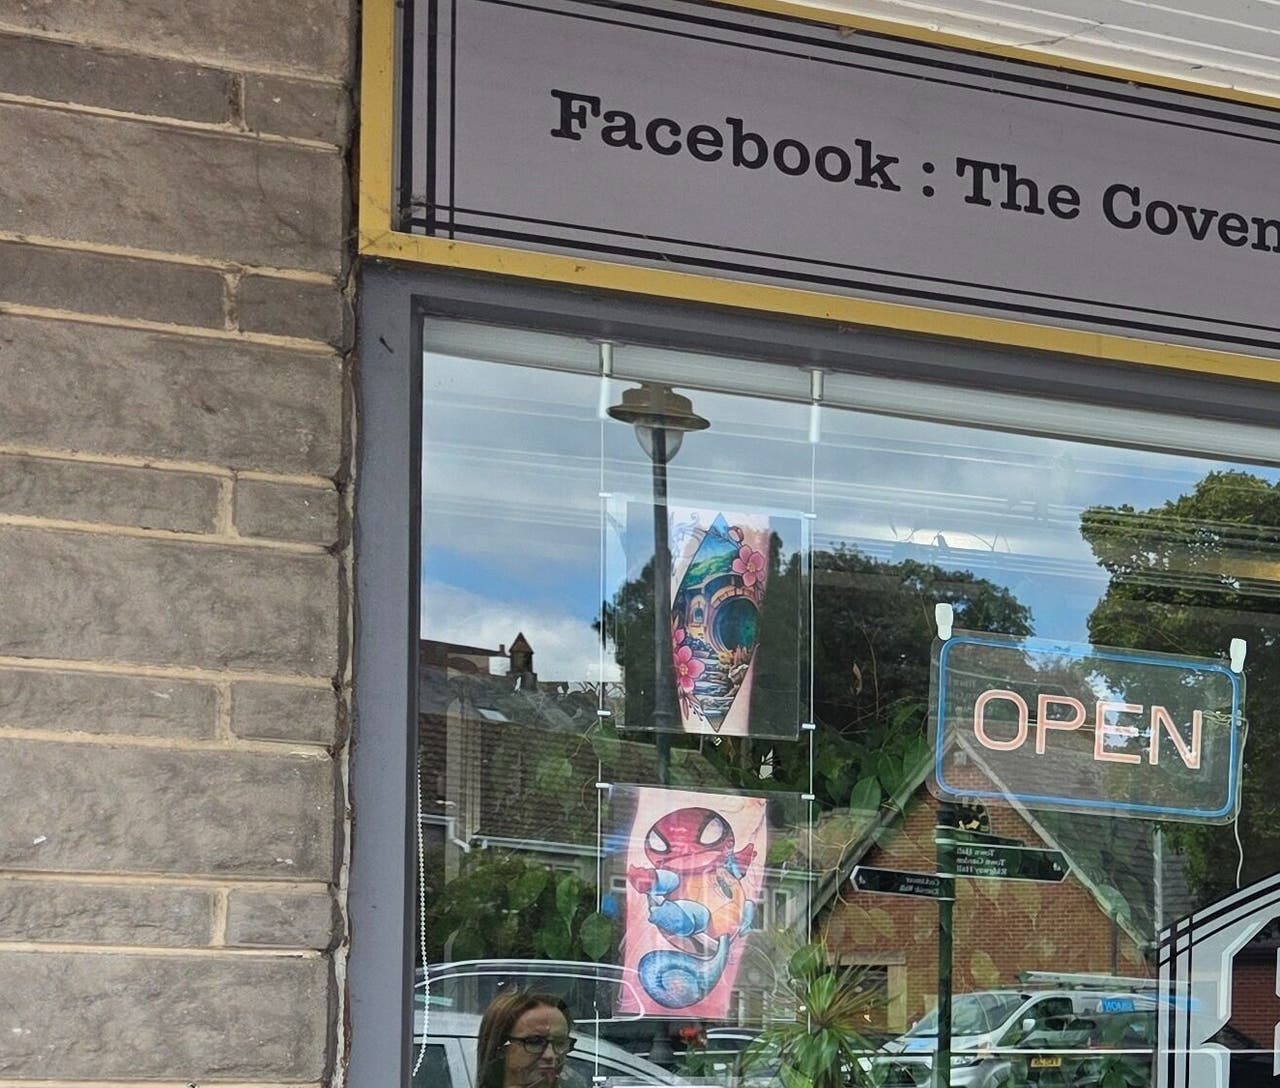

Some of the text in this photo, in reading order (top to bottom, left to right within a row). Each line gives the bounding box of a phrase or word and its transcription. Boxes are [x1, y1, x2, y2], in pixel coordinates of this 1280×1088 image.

[550, 88, 902, 192] Facebook
[955, 156, 1081, 220] The
[973, 688, 1203, 770] OPEN
